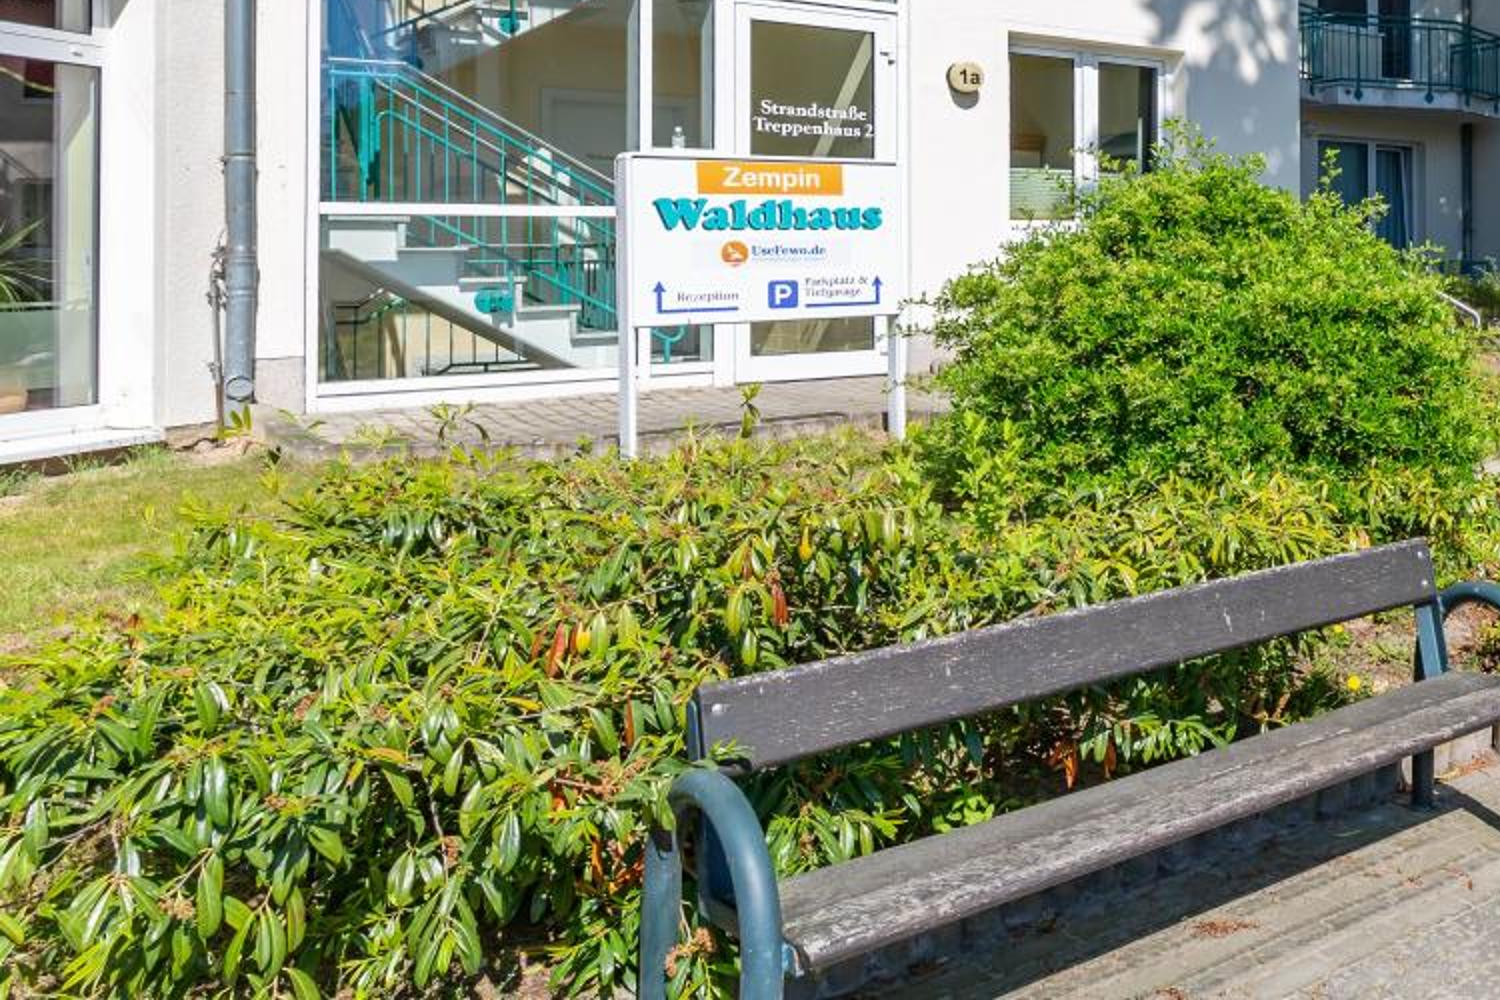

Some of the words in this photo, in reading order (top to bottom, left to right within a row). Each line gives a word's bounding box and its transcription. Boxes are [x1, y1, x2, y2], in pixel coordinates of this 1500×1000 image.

[960, 68, 981, 85] 1a
[761, 99, 867, 121] Strandstraße
[752, 115, 861, 137] Treppenhaus
[865, 124, 875, 137] 2
[722, 166, 820, 191] Zempin
[653, 198, 882, 230] Waldhaus
[677, 291, 739, 303] Rezeption
